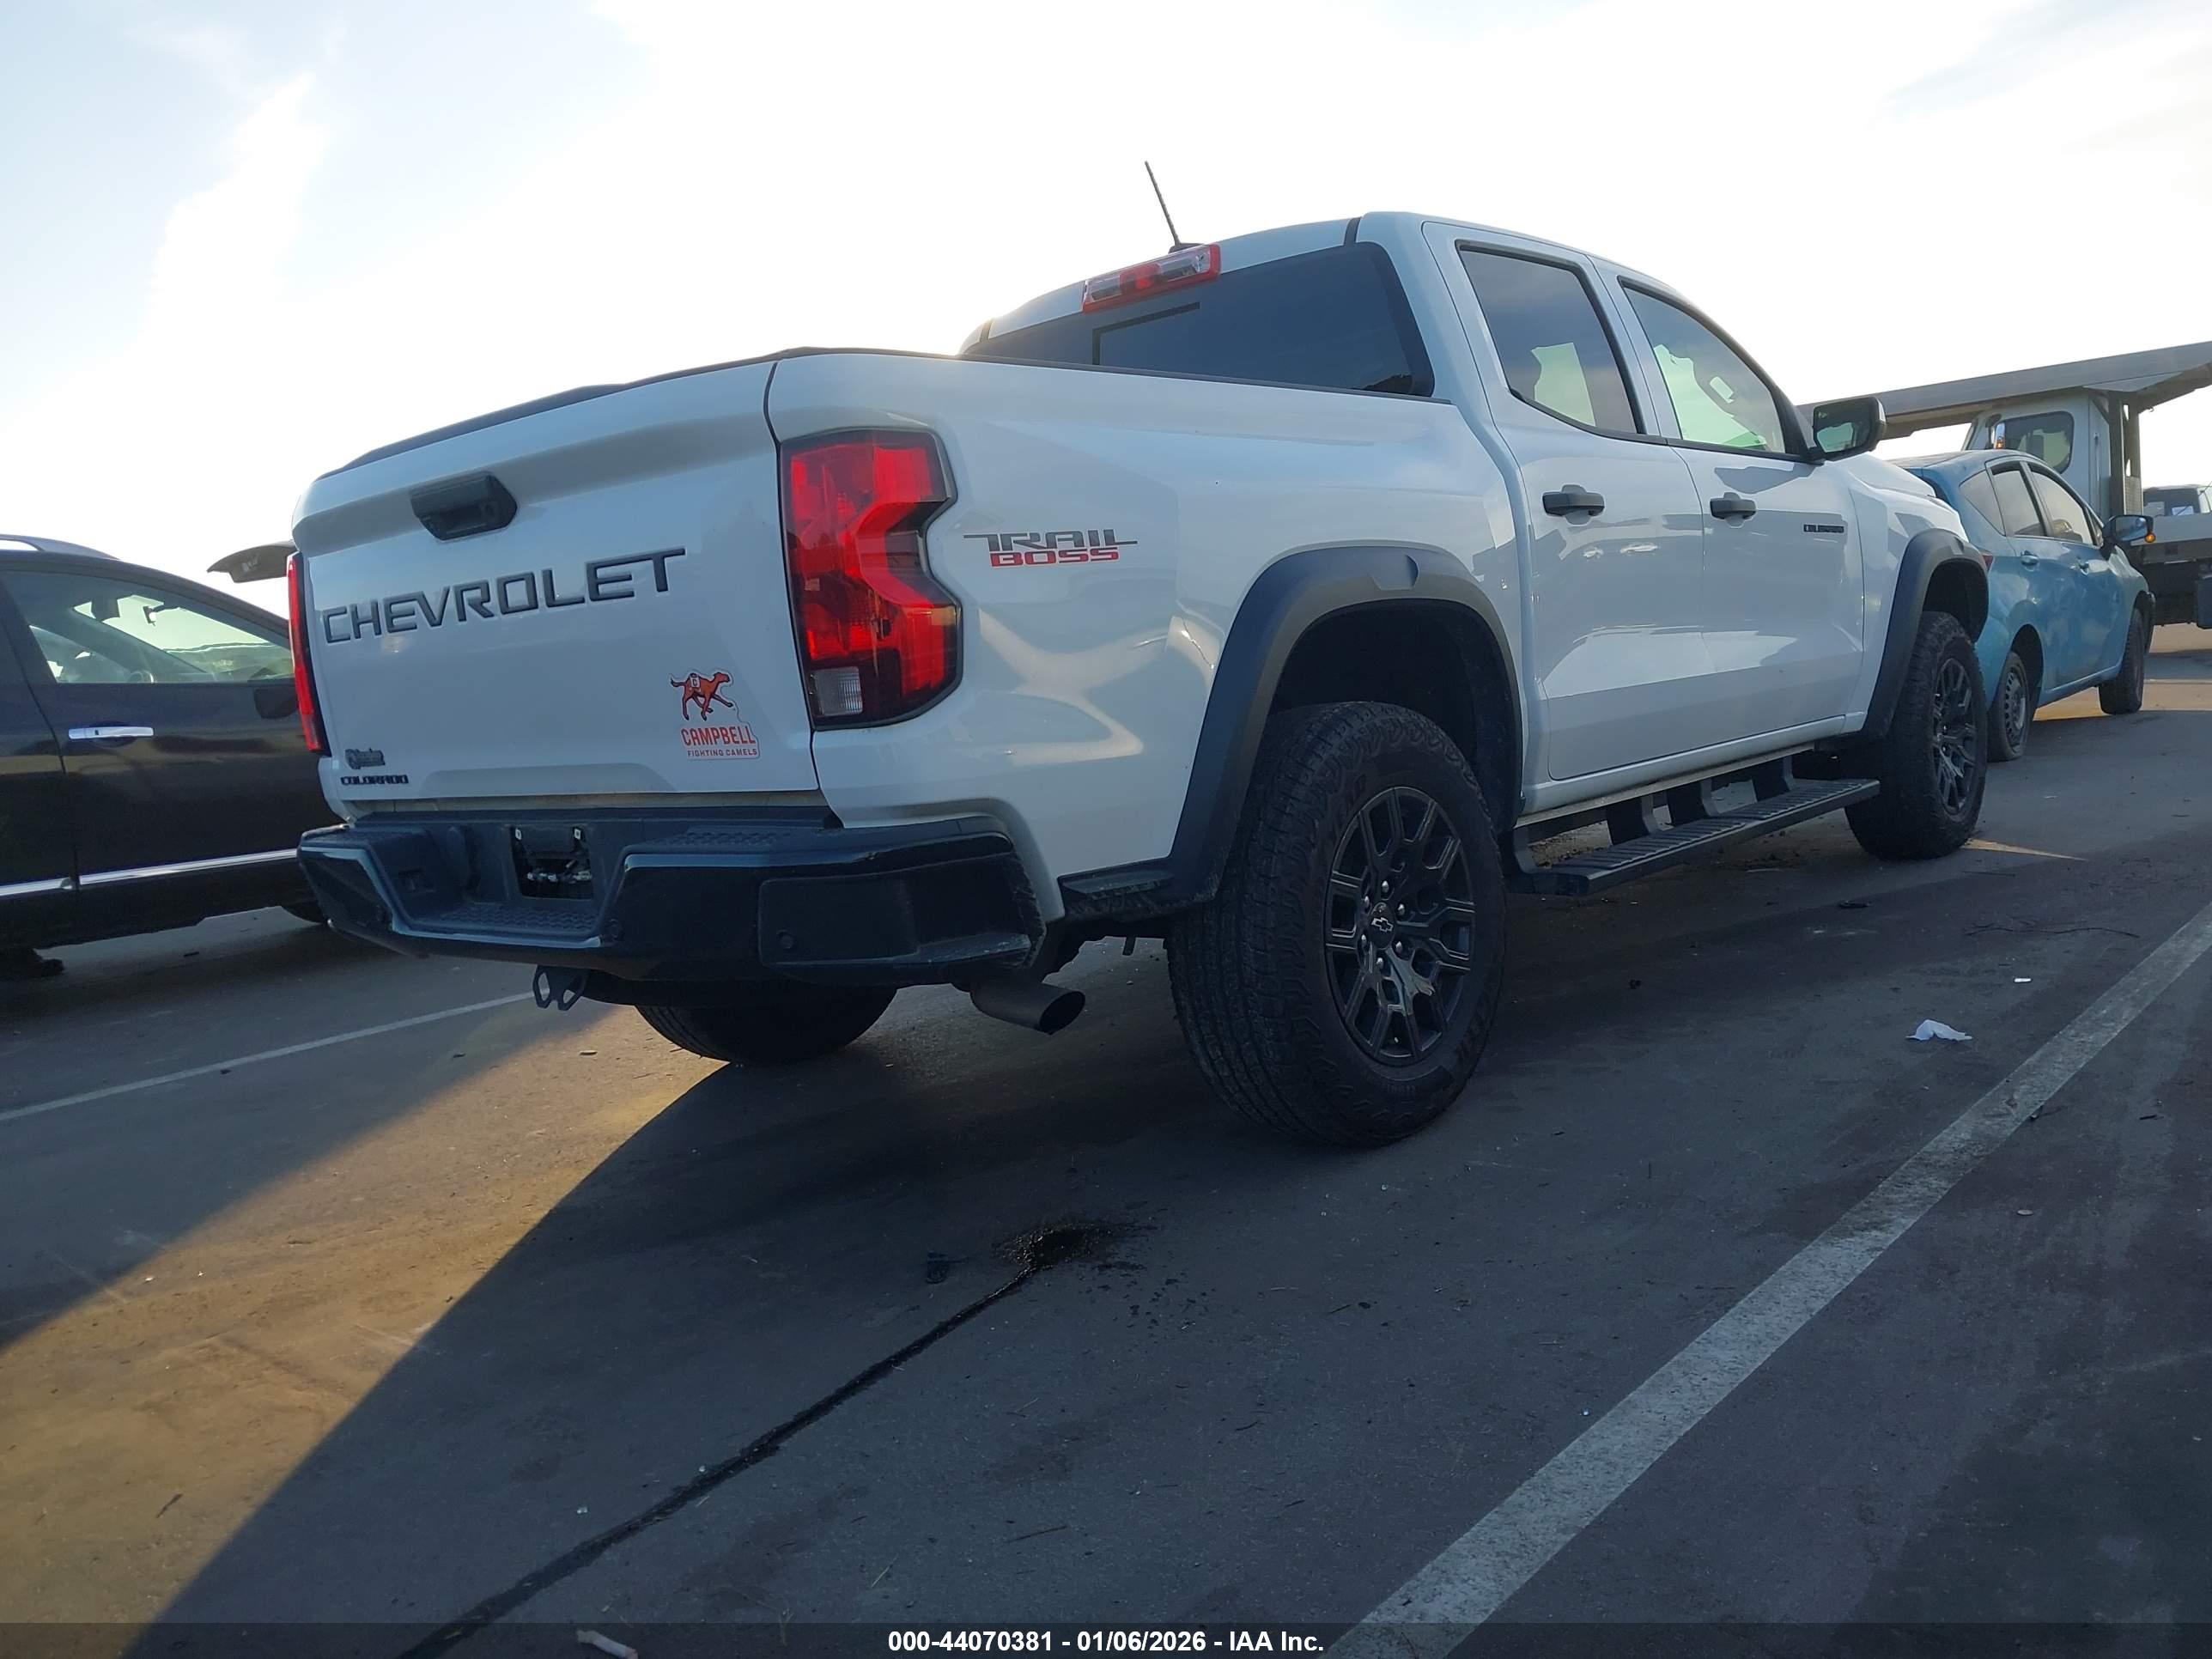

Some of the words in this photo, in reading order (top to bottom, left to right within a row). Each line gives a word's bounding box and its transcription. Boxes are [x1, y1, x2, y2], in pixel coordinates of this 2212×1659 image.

[963, 529, 1138, 552] TRAIL
[990, 547, 1120, 568] BOSS
[322, 548, 686, 643] CHEVROLET
[681, 726, 757, 746] CAMPBELL
[687, 749, 724, 757] FIGHTING
[726, 748, 757, 757] CAMELS
[340, 775, 409, 786] COLORADO
